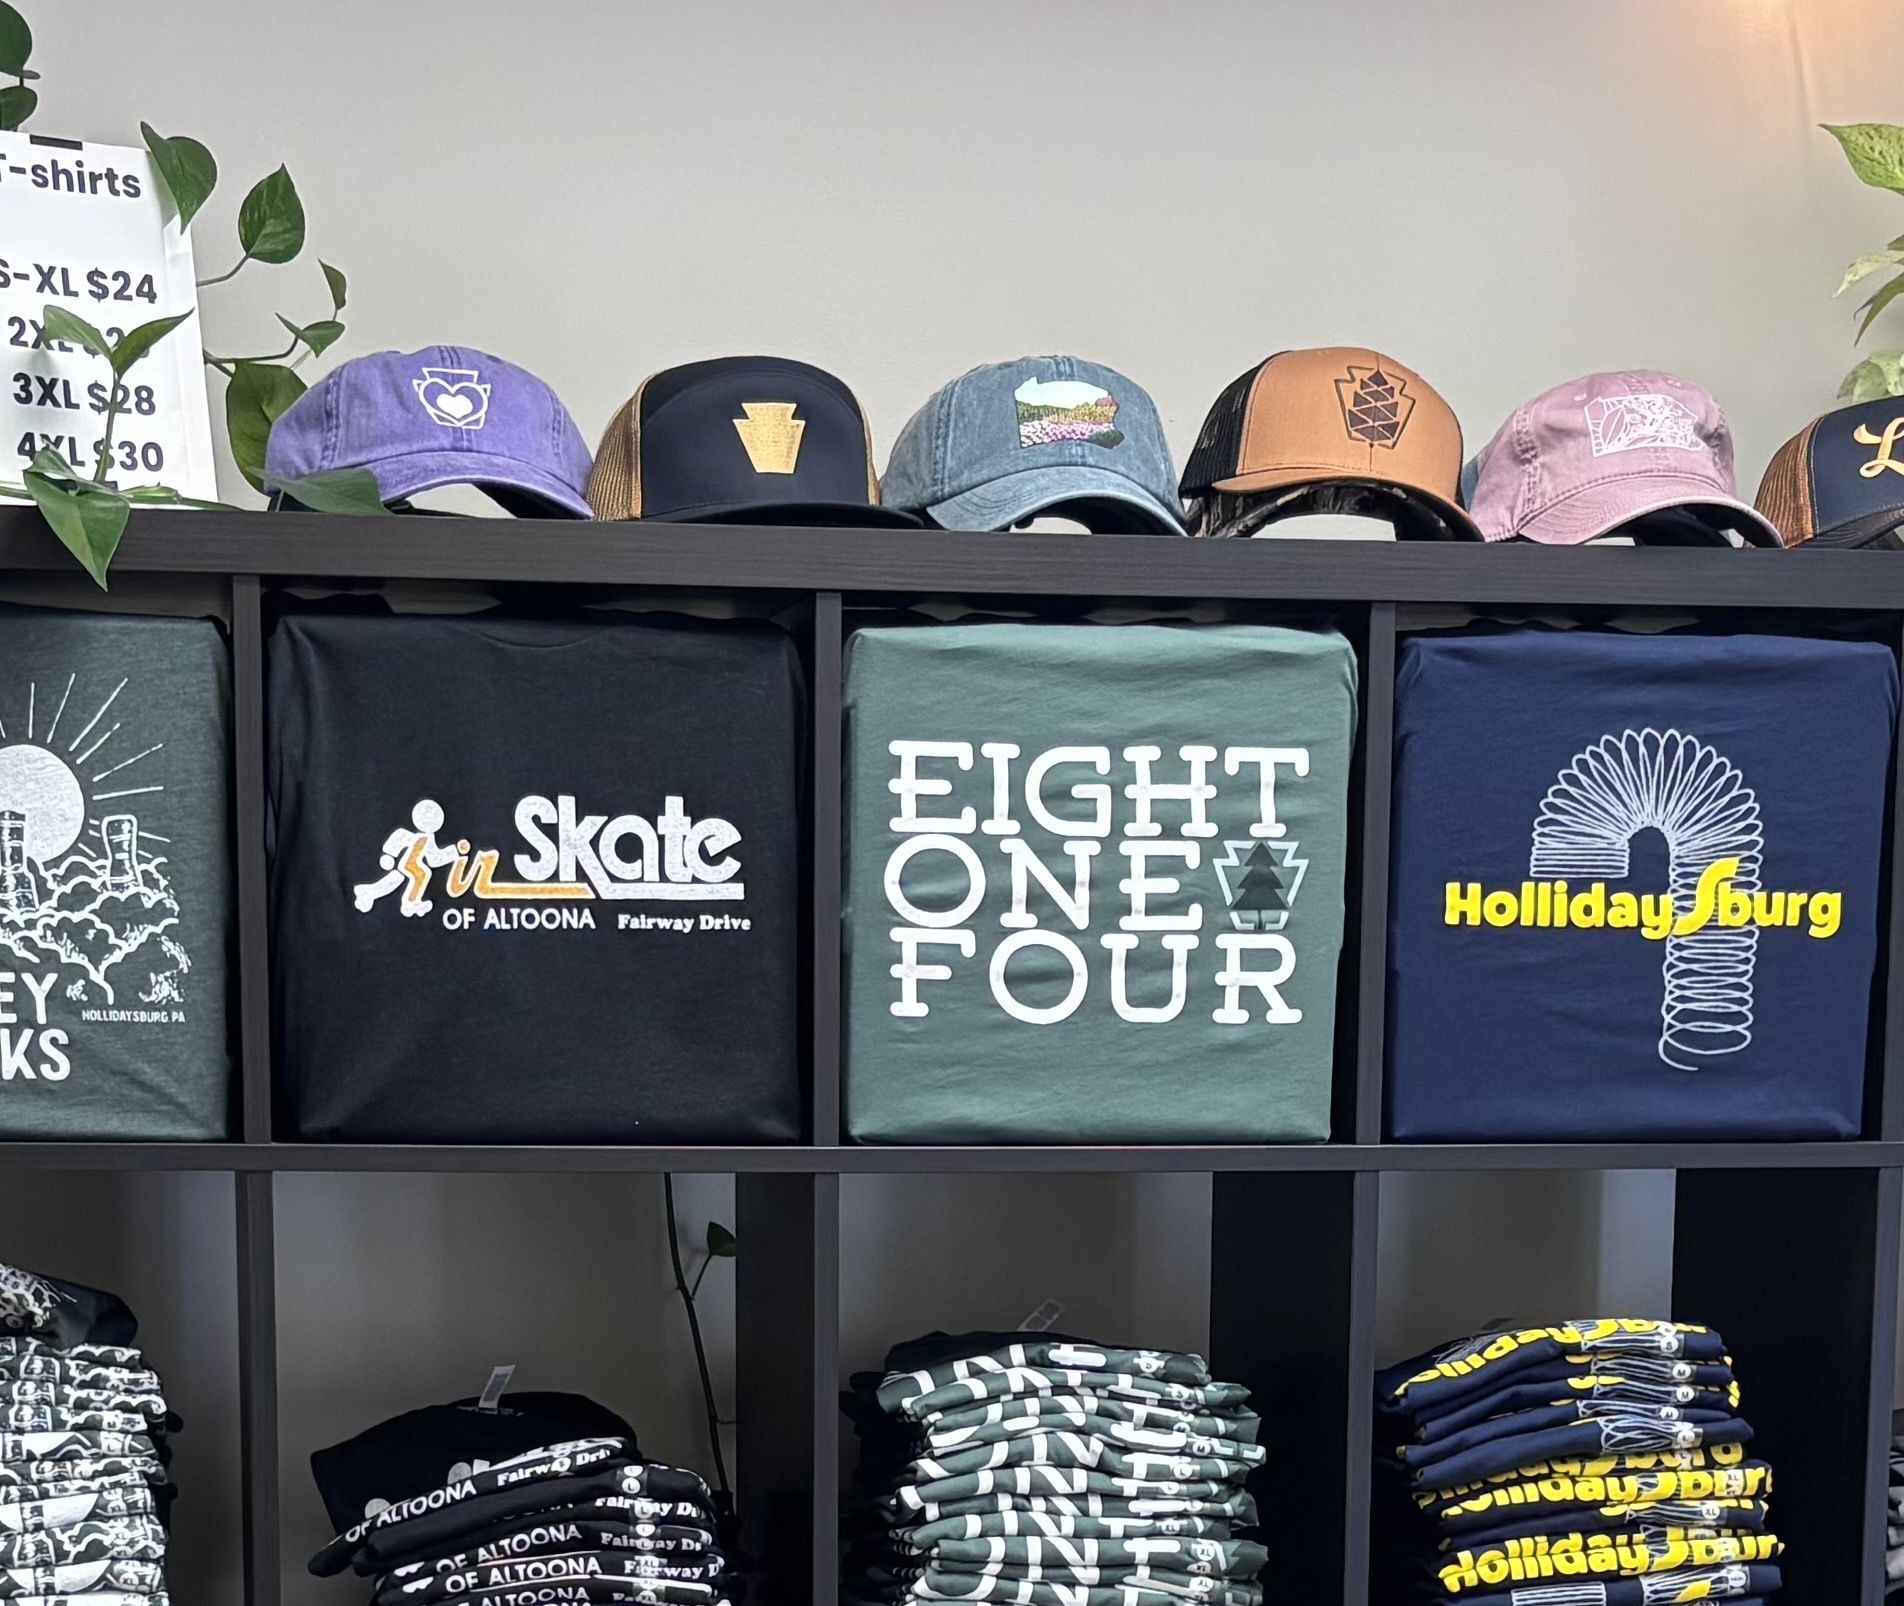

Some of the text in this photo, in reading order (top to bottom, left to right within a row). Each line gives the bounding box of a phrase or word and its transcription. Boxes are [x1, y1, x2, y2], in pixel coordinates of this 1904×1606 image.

[87, 267, 157, 304] $24
[13, 372, 156, 417] 3XL $28
[888, 740, 1310, 838] EIGHT
[513, 795, 746, 900] Skate
[884, 833, 1203, 931] ONE
[442, 907, 752, 934] OF ALTOONA Fairway Drive
[889, 927, 1303, 1025] FOUR
[81, 1009, 186, 1023] HOLLIDAYSBURG PA
[376, 1479, 477, 1528] ALTOONA
[478, 1524, 582, 1563] ALTOONA
[446, 1556, 603, 1594] OF ALTOONA
